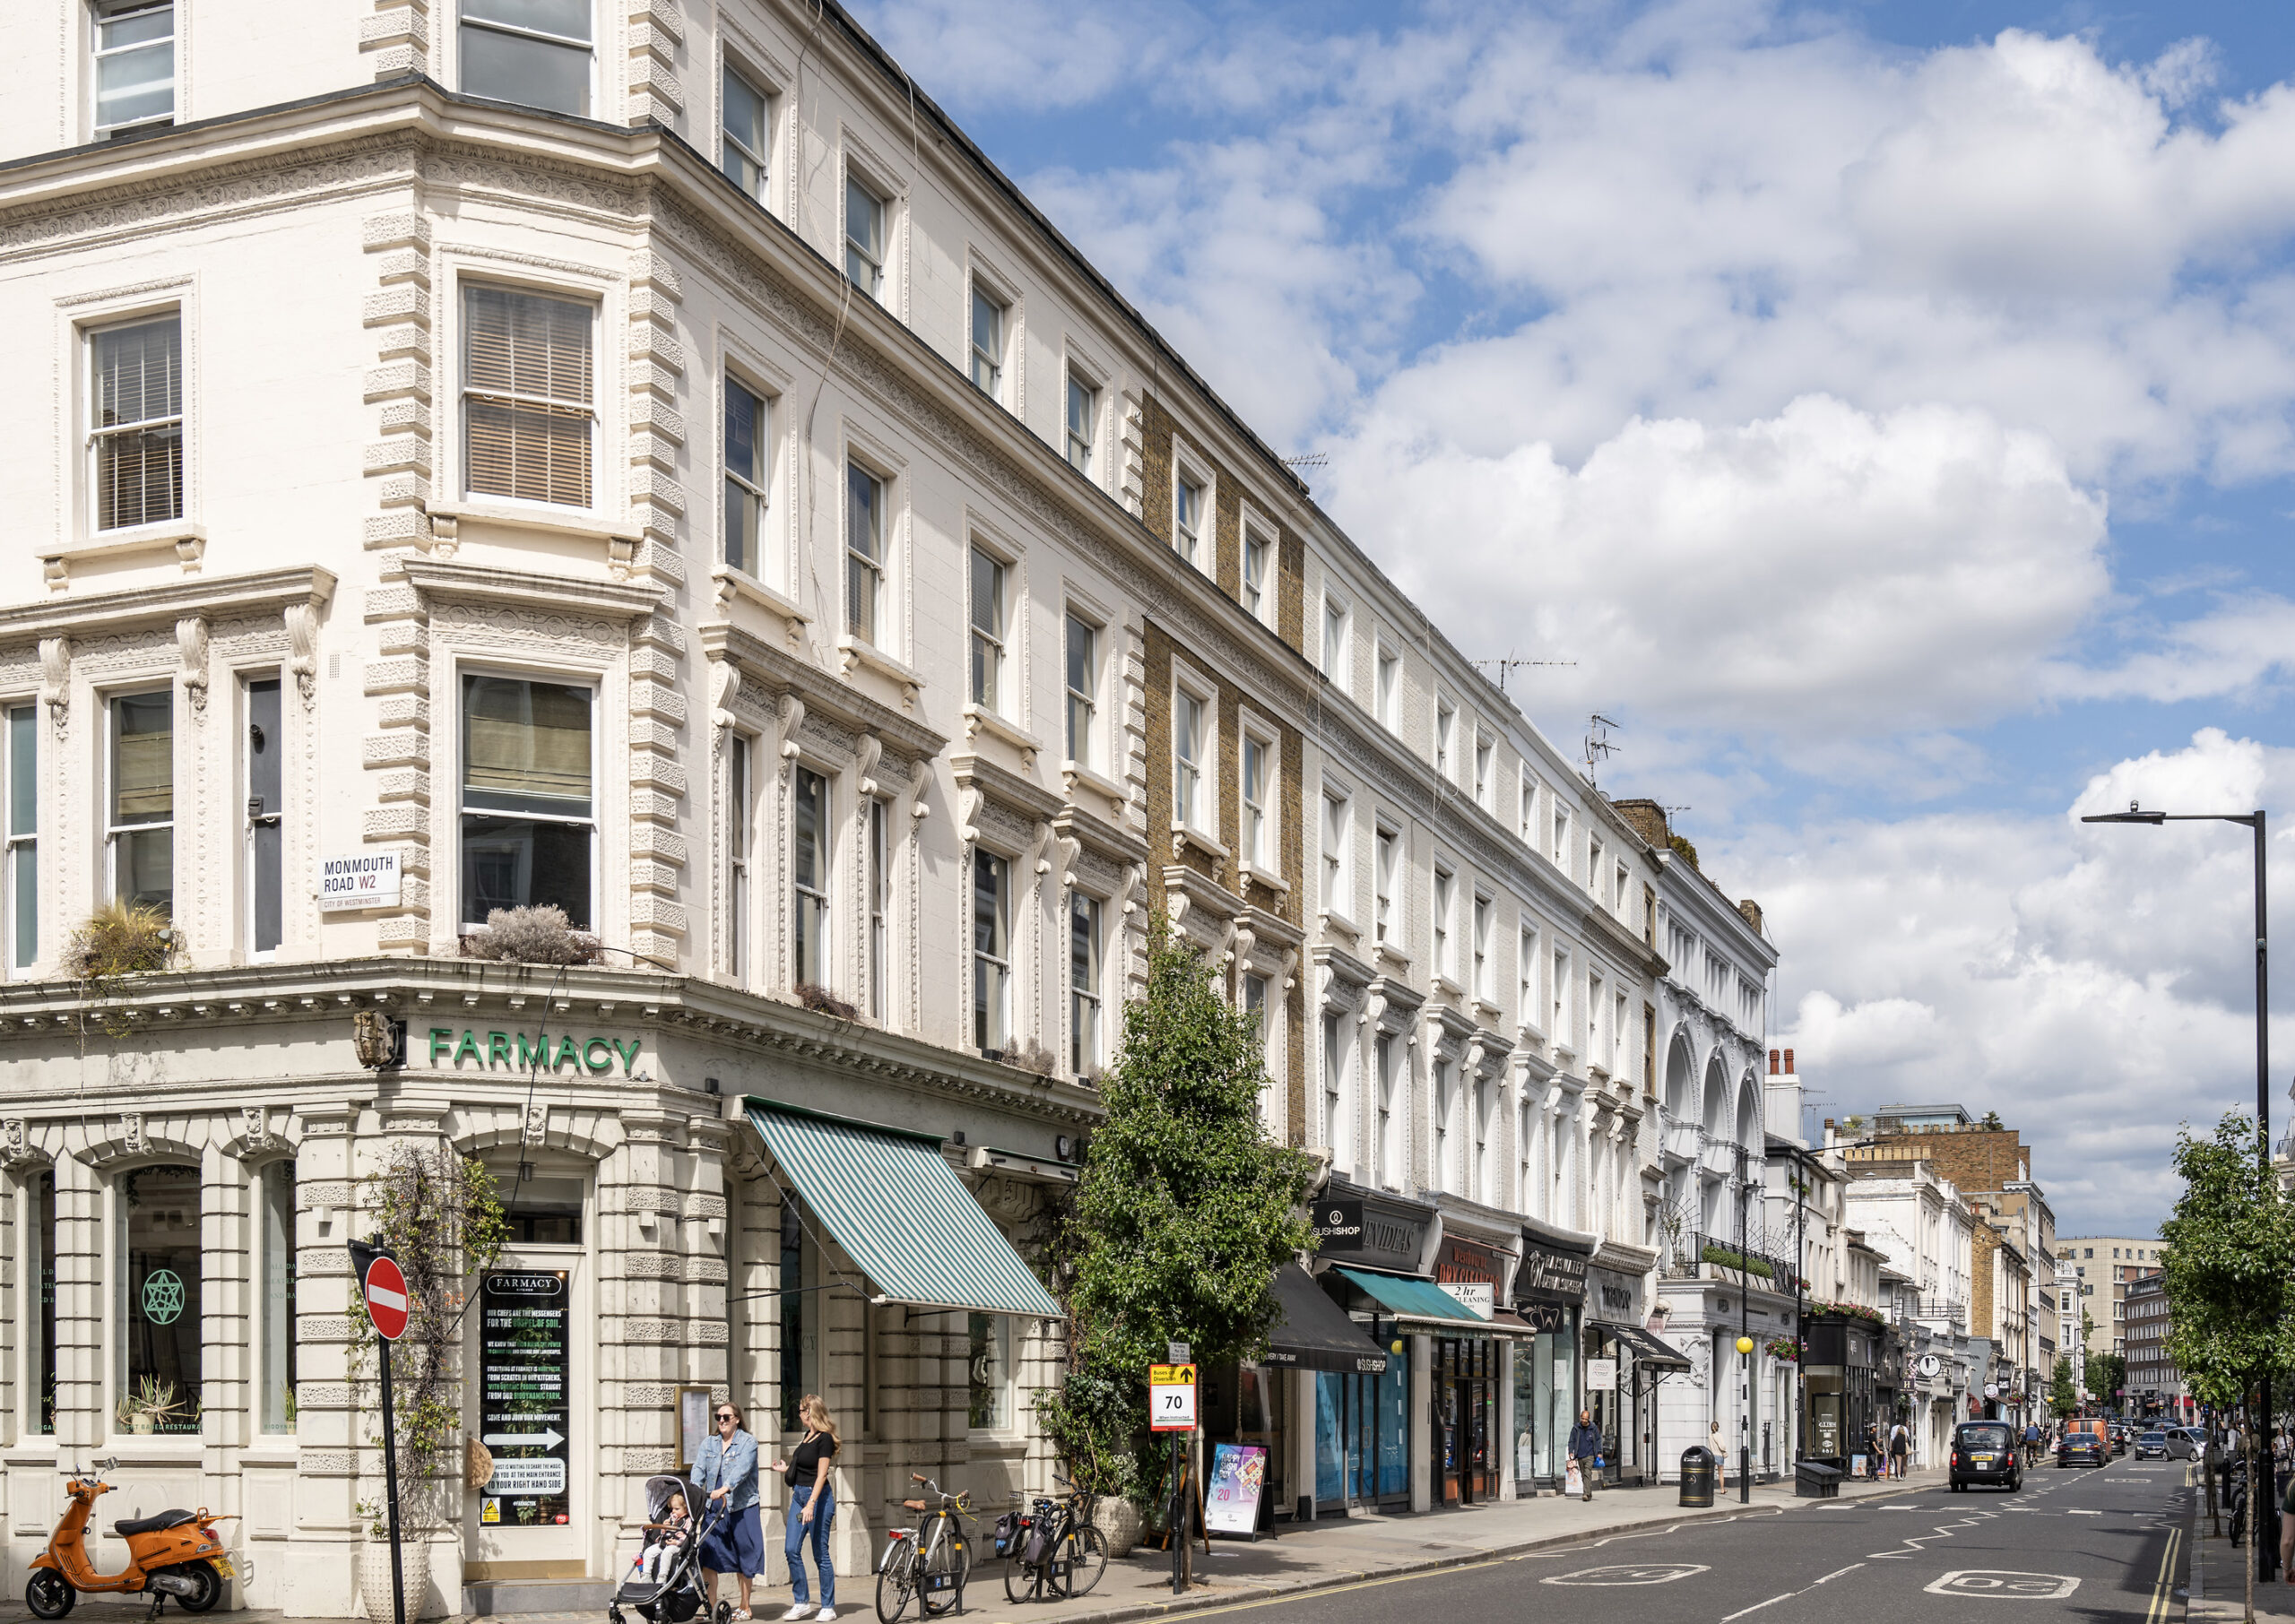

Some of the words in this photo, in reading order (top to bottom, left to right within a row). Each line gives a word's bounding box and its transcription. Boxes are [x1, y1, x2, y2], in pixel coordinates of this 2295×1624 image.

[325, 856, 393, 876] MONMOUTH
[325, 877, 354, 893] ROAD
[359, 875, 376, 889] W2
[344, 897, 380, 905] WESTMINSTER
[429, 1028, 641, 1070] FARMACY
[1312, 1227, 1360, 1236] SUSHISHOP
[1380, 1223, 1416, 1254] IDEAS
[1439, 1263, 1459, 1284] DRY
[497, 1278, 552, 1288] FARMACY
[1454, 1286, 1461, 1296] 2
[1463, 1286, 1476, 1296] hr
[532, 1309, 562, 1317] MESSENGERS
[487, 1318, 499, 1327] FOR
[500, 1318, 512, 1327] THE
[538, 1319, 545, 1328] OF
[1260, 1352, 1277, 1361] LIVERY
[1279, 1353, 1287, 1361] TAKE
[1165, 1396, 1182, 1409] 70
[1221, 1453, 1241, 1463] HAPPY
[488, 1481, 495, 1489] TO
[496, 1480, 512, 1489] YOUR
[513, 1480, 530, 1489] RIGHT
[531, 1480, 547, 1489] HAND
[548, 1480, 561, 1489] SIDE
[1217, 1489, 1230, 1501] 20
